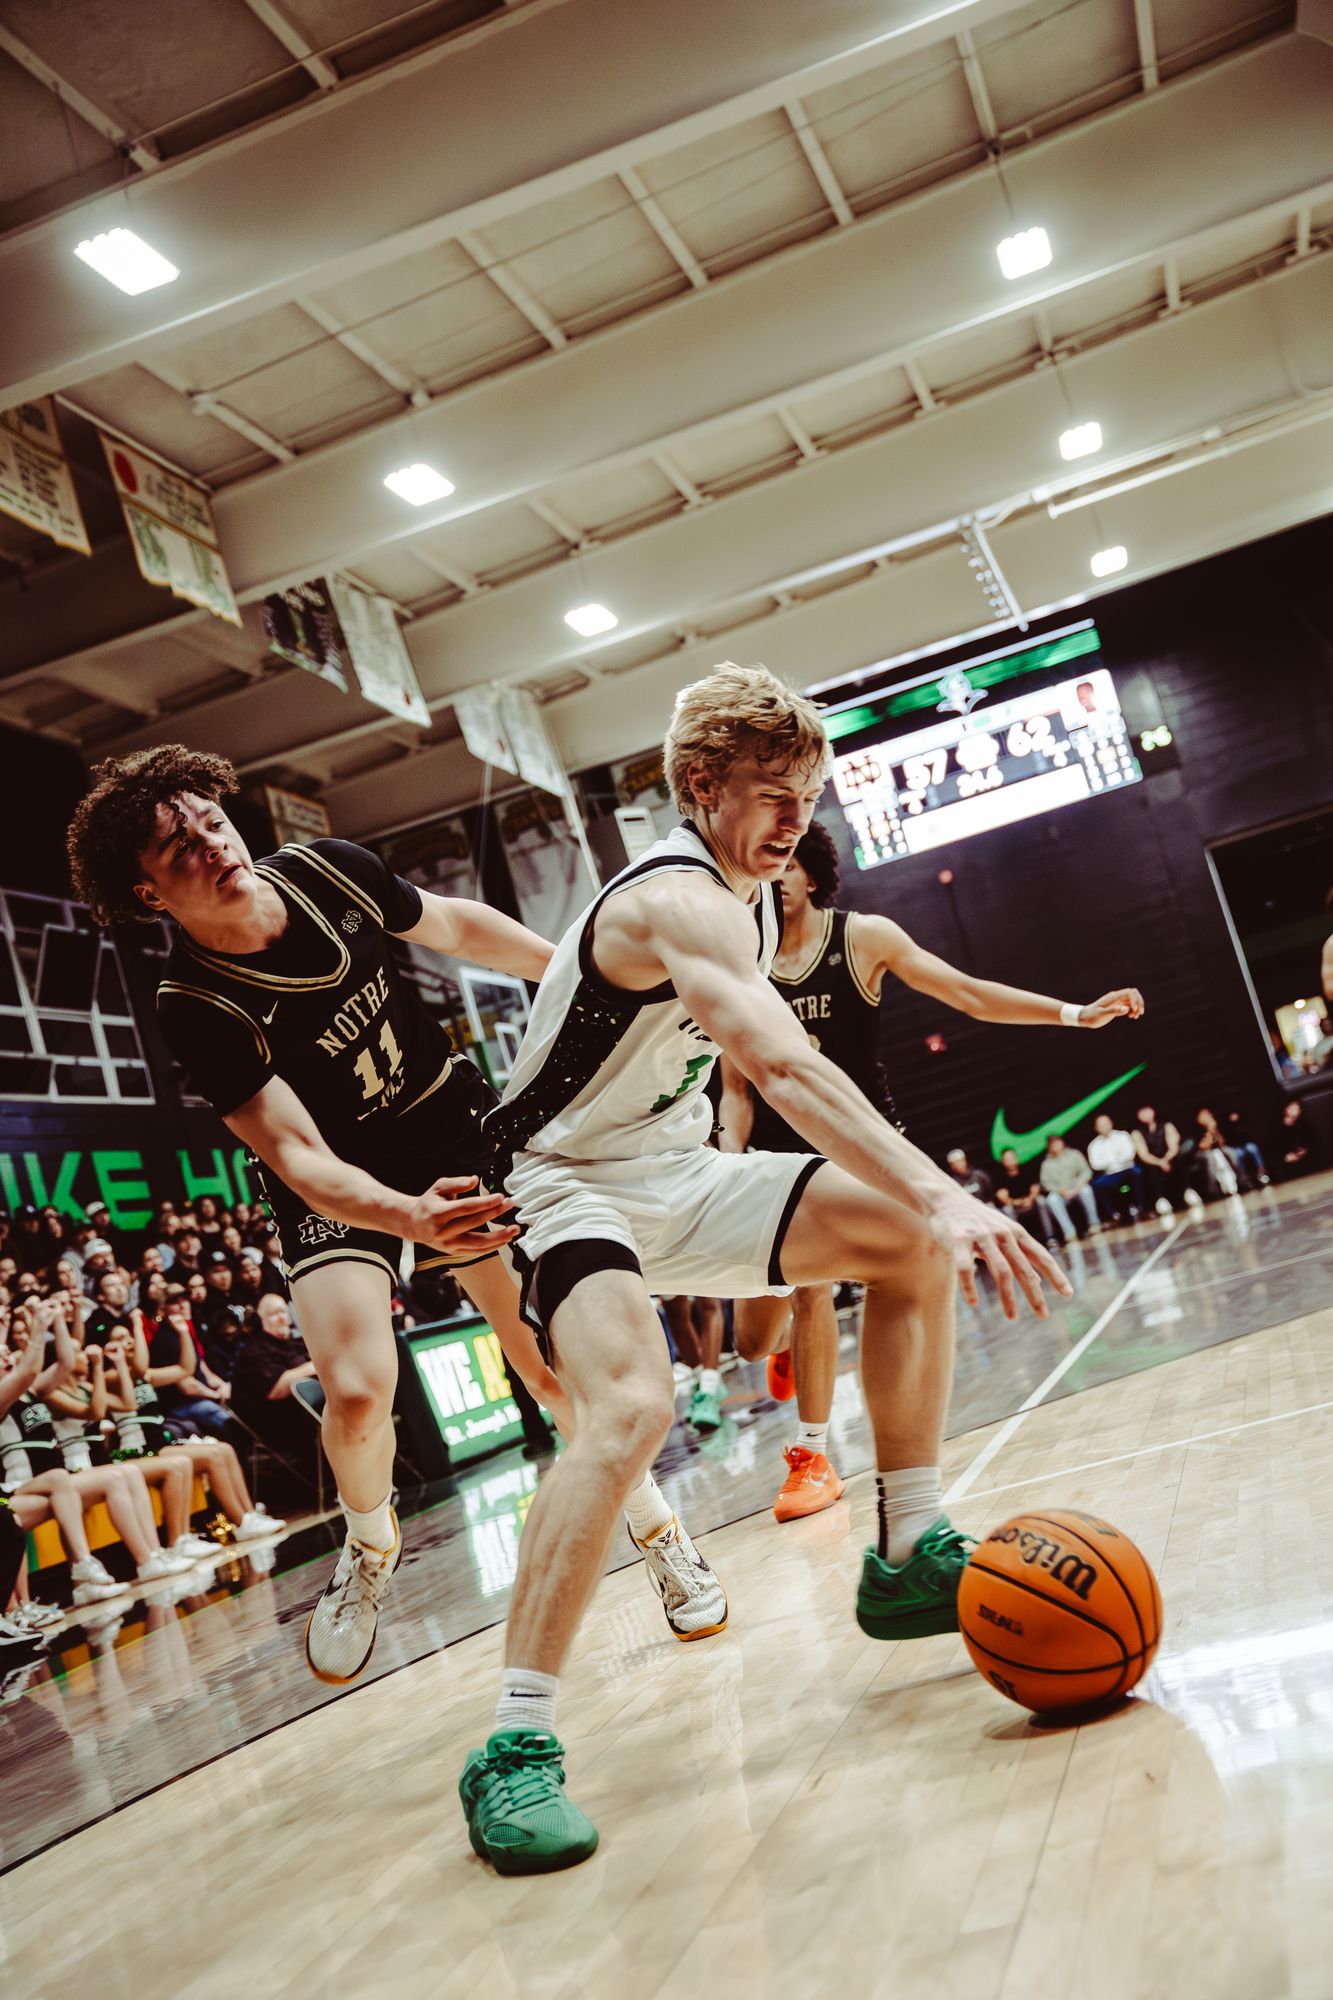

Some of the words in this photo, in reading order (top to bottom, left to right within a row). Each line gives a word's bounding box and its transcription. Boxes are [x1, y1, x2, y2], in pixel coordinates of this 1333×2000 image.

[902, 748, 948, 790] 57
[316, 965, 390, 1058] NOTRE
[787, 993, 832, 1021] TRE
[353, 1019, 403, 1100] 11
